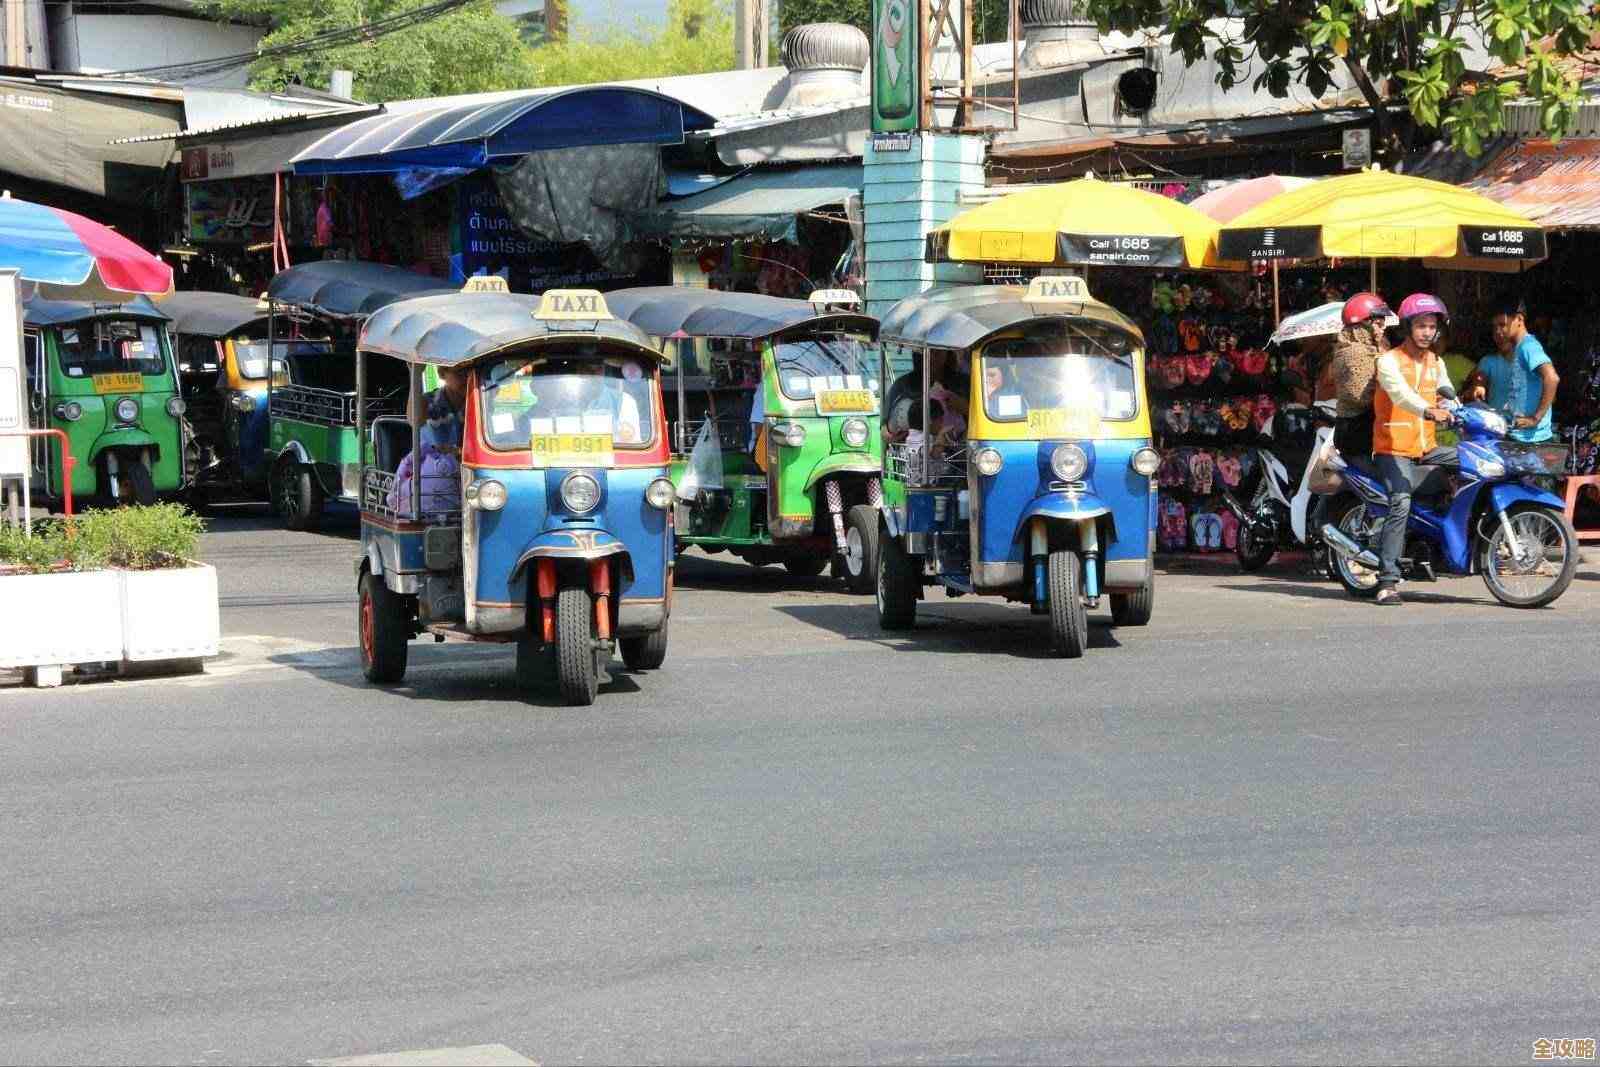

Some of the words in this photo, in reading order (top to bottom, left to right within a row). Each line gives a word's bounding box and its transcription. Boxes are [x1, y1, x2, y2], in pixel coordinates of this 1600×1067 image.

[1482, 232, 1497, 242] Call
[1498, 230, 1524, 243] 1685
[1089, 239, 1110, 249] Call
[1113, 237, 1151, 250] 1685
[1089, 252, 1150, 261] sansiri.com
[1251, 249, 1285, 257] SANSIRI
[1482, 246, 1524, 255] sansiri.com
[473, 280, 503, 291] TAXI
[1040, 281, 1080, 296] TAXI
[550, 295, 600, 312] TAXI
